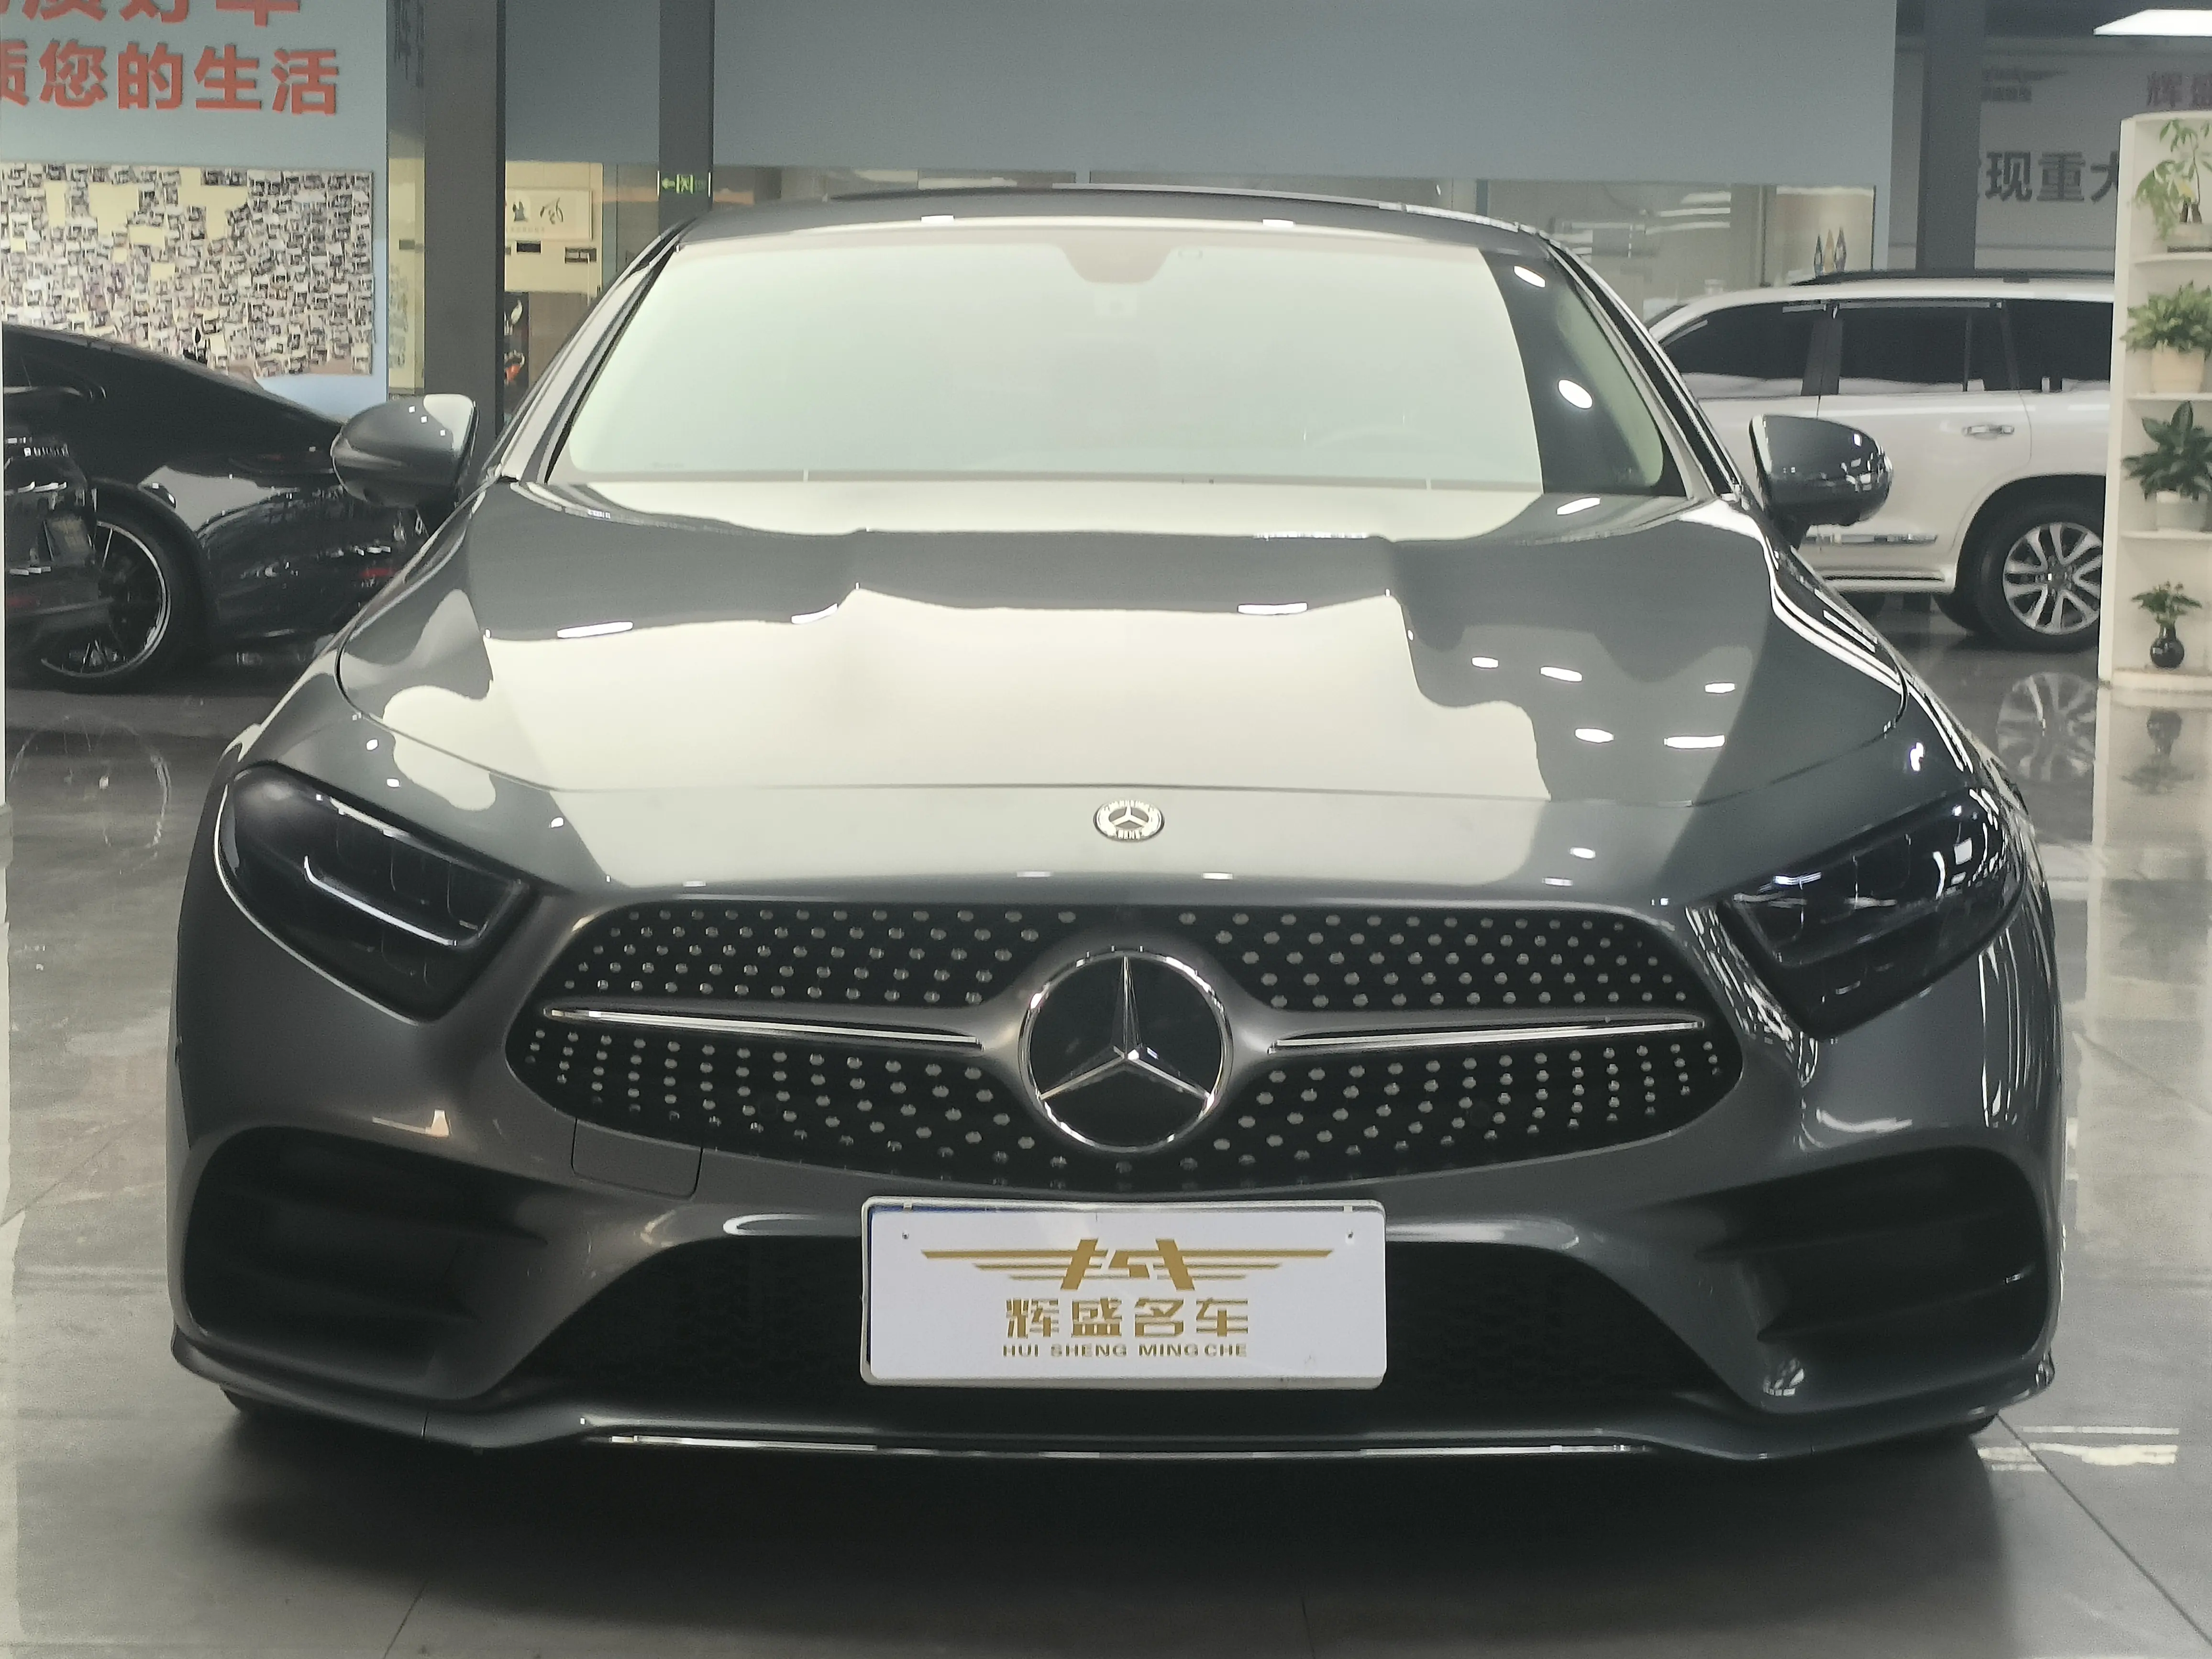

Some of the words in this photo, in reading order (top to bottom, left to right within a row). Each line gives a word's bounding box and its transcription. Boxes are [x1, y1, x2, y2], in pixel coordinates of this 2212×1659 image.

[1006, 1297, 1249, 1339] 辉盛名车
[1003, 1343, 1039, 1358] HUI
[1051, 1343, 1127, 1358] SHENG
[1138, 1343, 1199, 1358] MING
[1204, 1343, 1247, 1358] CHE
